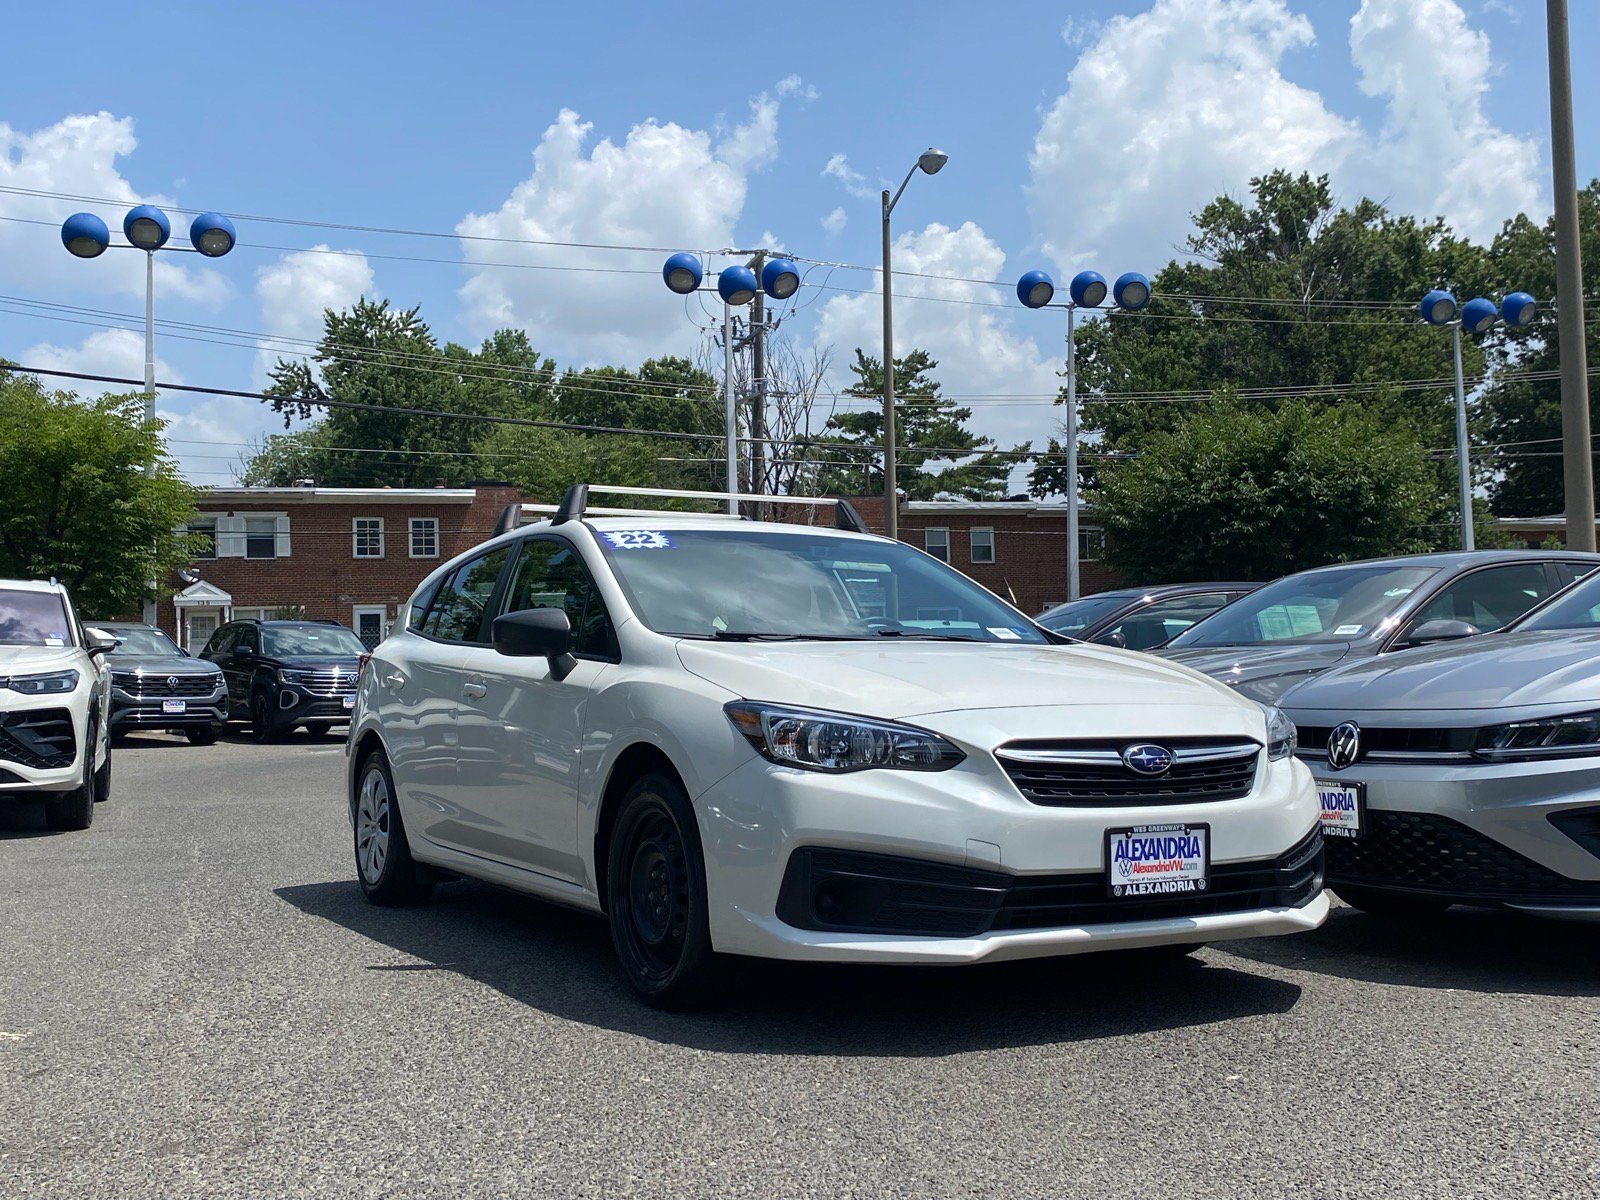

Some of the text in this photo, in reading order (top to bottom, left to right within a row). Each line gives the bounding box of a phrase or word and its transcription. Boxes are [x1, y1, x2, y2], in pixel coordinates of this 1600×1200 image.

[620, 533, 657, 545] 22
[1114, 836, 1201, 862] ALEXANDRIA
[1133, 860, 1198, 874] AlexandriaVW.com
[1125, 880, 1196, 896] ALEXANDRIA
